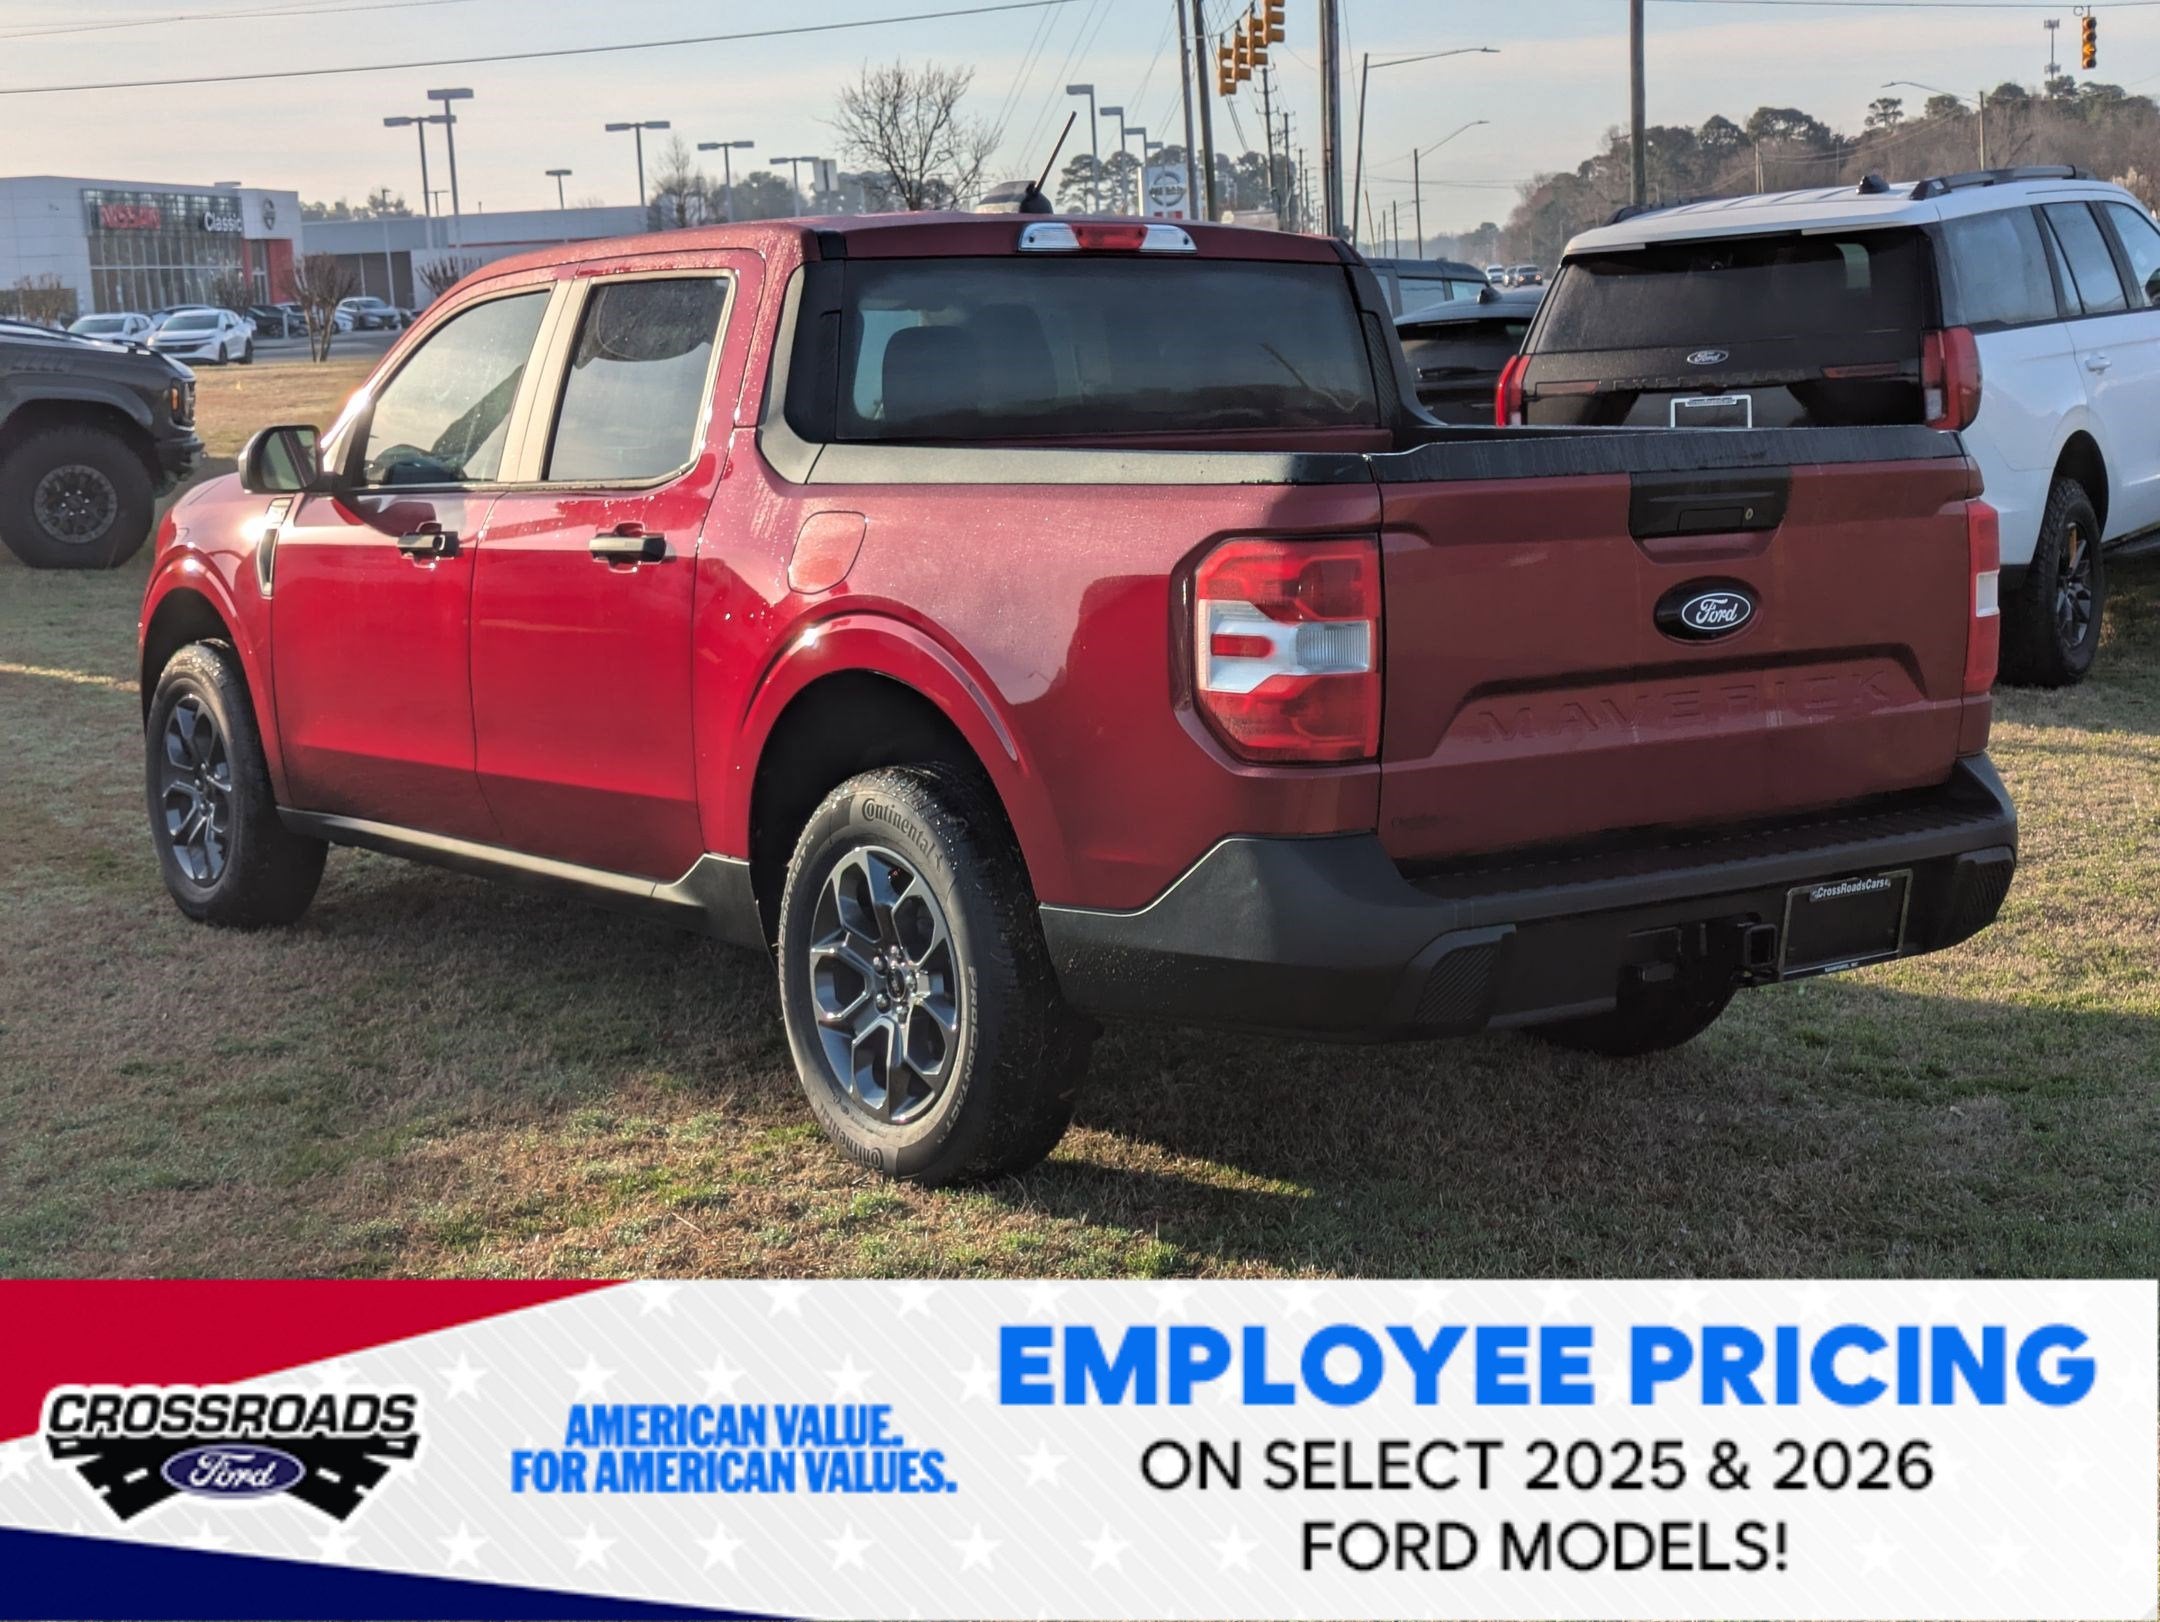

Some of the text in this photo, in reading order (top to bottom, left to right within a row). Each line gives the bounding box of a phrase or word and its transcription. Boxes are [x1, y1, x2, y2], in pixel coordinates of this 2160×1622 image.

[203, 210, 243, 232] Classic
[1691, 350, 1724, 363] Ford
[1696, 598, 1739, 624] Ford
[1477, 669, 1890, 745] MAVERICK
[861, 797, 937, 859] Continental
